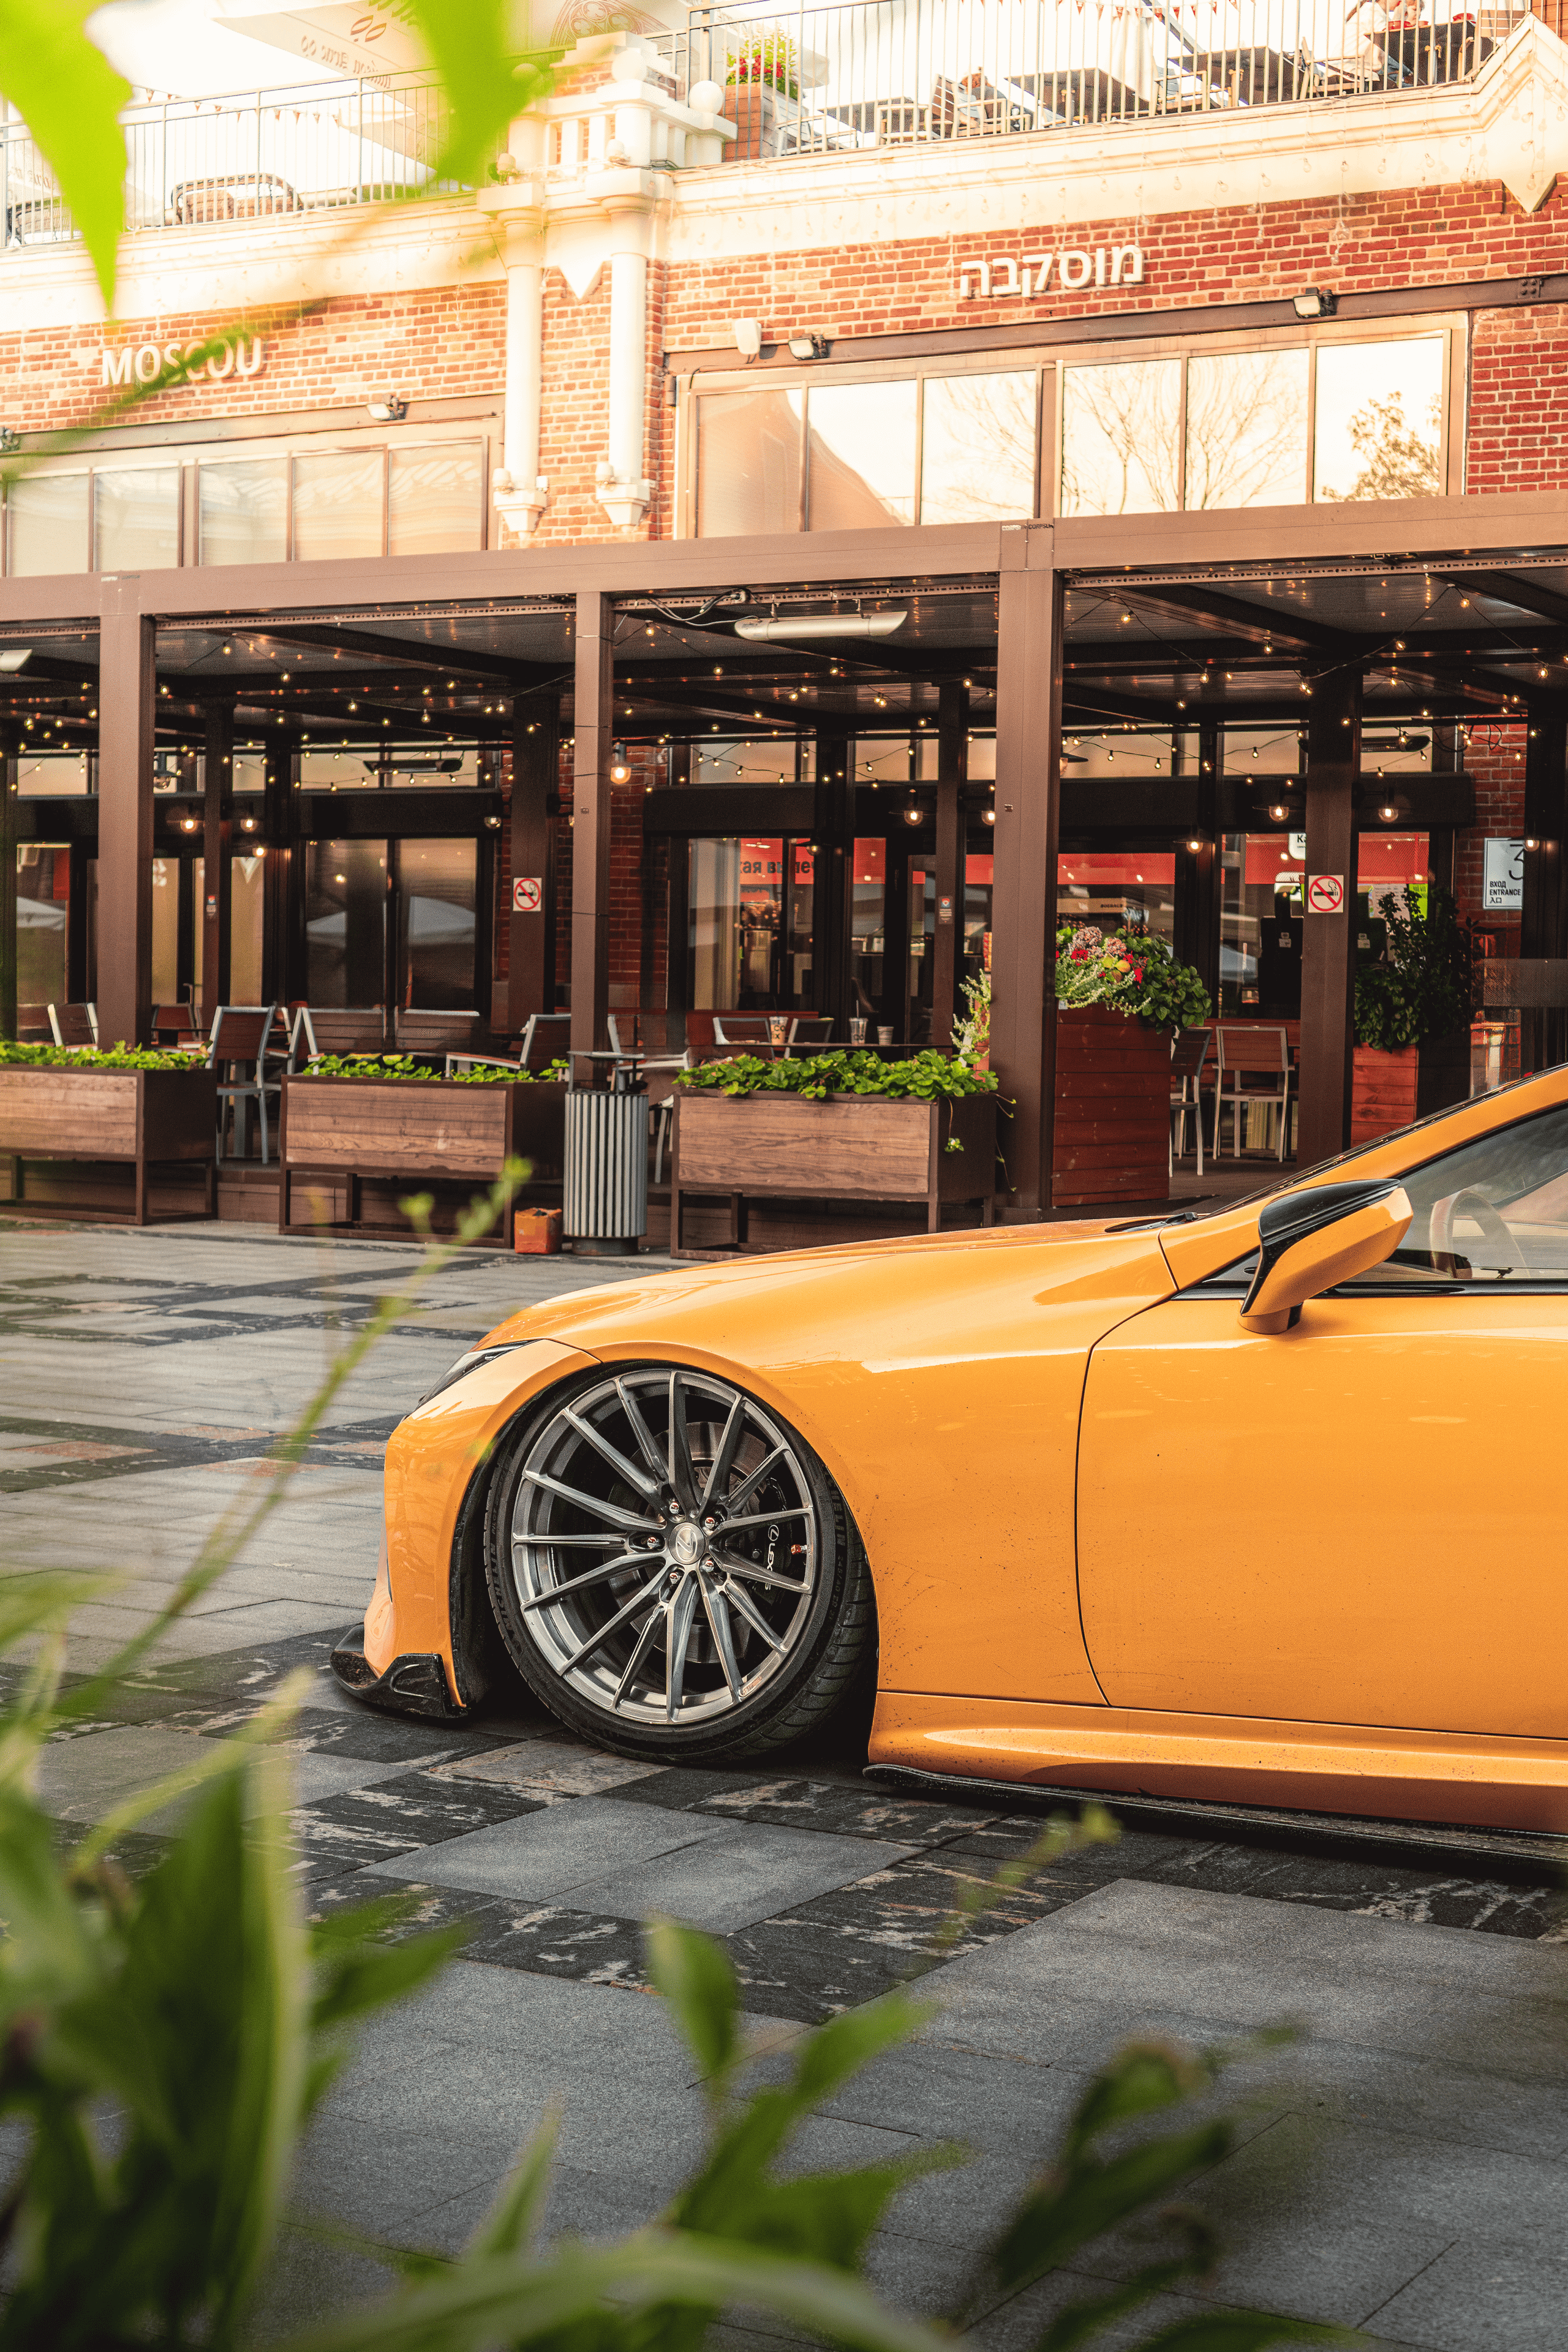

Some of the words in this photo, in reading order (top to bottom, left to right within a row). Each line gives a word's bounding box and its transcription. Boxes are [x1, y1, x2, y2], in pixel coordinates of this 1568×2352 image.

[959, 244, 1144, 298] מוסקבה
[102, 336, 262, 386] MOSCOU
[740, 861, 762, 873] ая
[765, 1542, 775, 1591] LEXS
